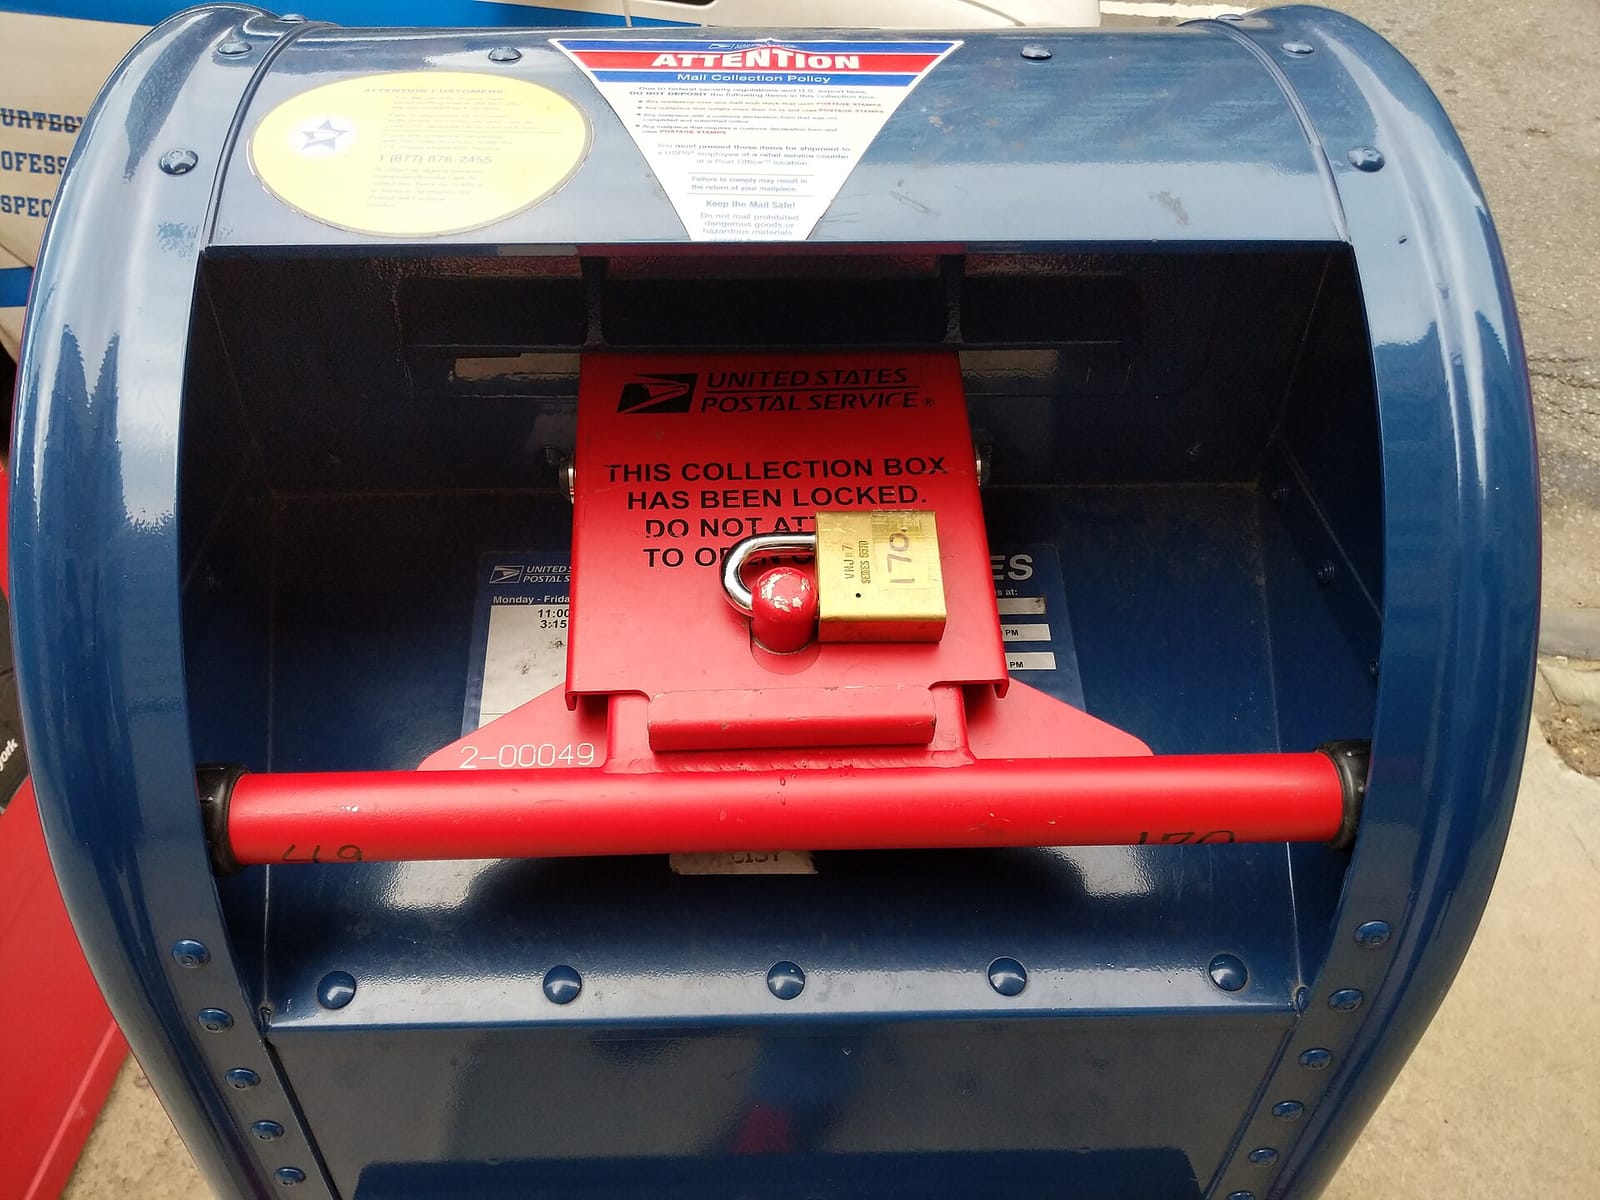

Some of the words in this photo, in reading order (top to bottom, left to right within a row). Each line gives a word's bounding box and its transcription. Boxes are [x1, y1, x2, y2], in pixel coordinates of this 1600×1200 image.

[651, 48, 860, 69] ATTENTION
[788, 75, 830, 83] Policy
[706, 200, 730, 209] Keep
[708, 370, 809, 388] UNITED
[816, 368, 907, 386] STATES
[702, 395, 801, 413] POSTAL
[604, 463, 671, 482] THIS
[681, 458, 880, 481] COLLECTION
[884, 456, 948, 476] BOX
[627, 490, 690, 510] HAS
[700, 488, 781, 508] BEEN
[793, 485, 927, 506] LOCKED.
[646, 518, 689, 538] DO
[700, 517, 763, 537] NOT
[643, 548, 684, 567] TO
[540, 620, 567, 628] 3:15
[459, 743, 594, 768] 2-00049
